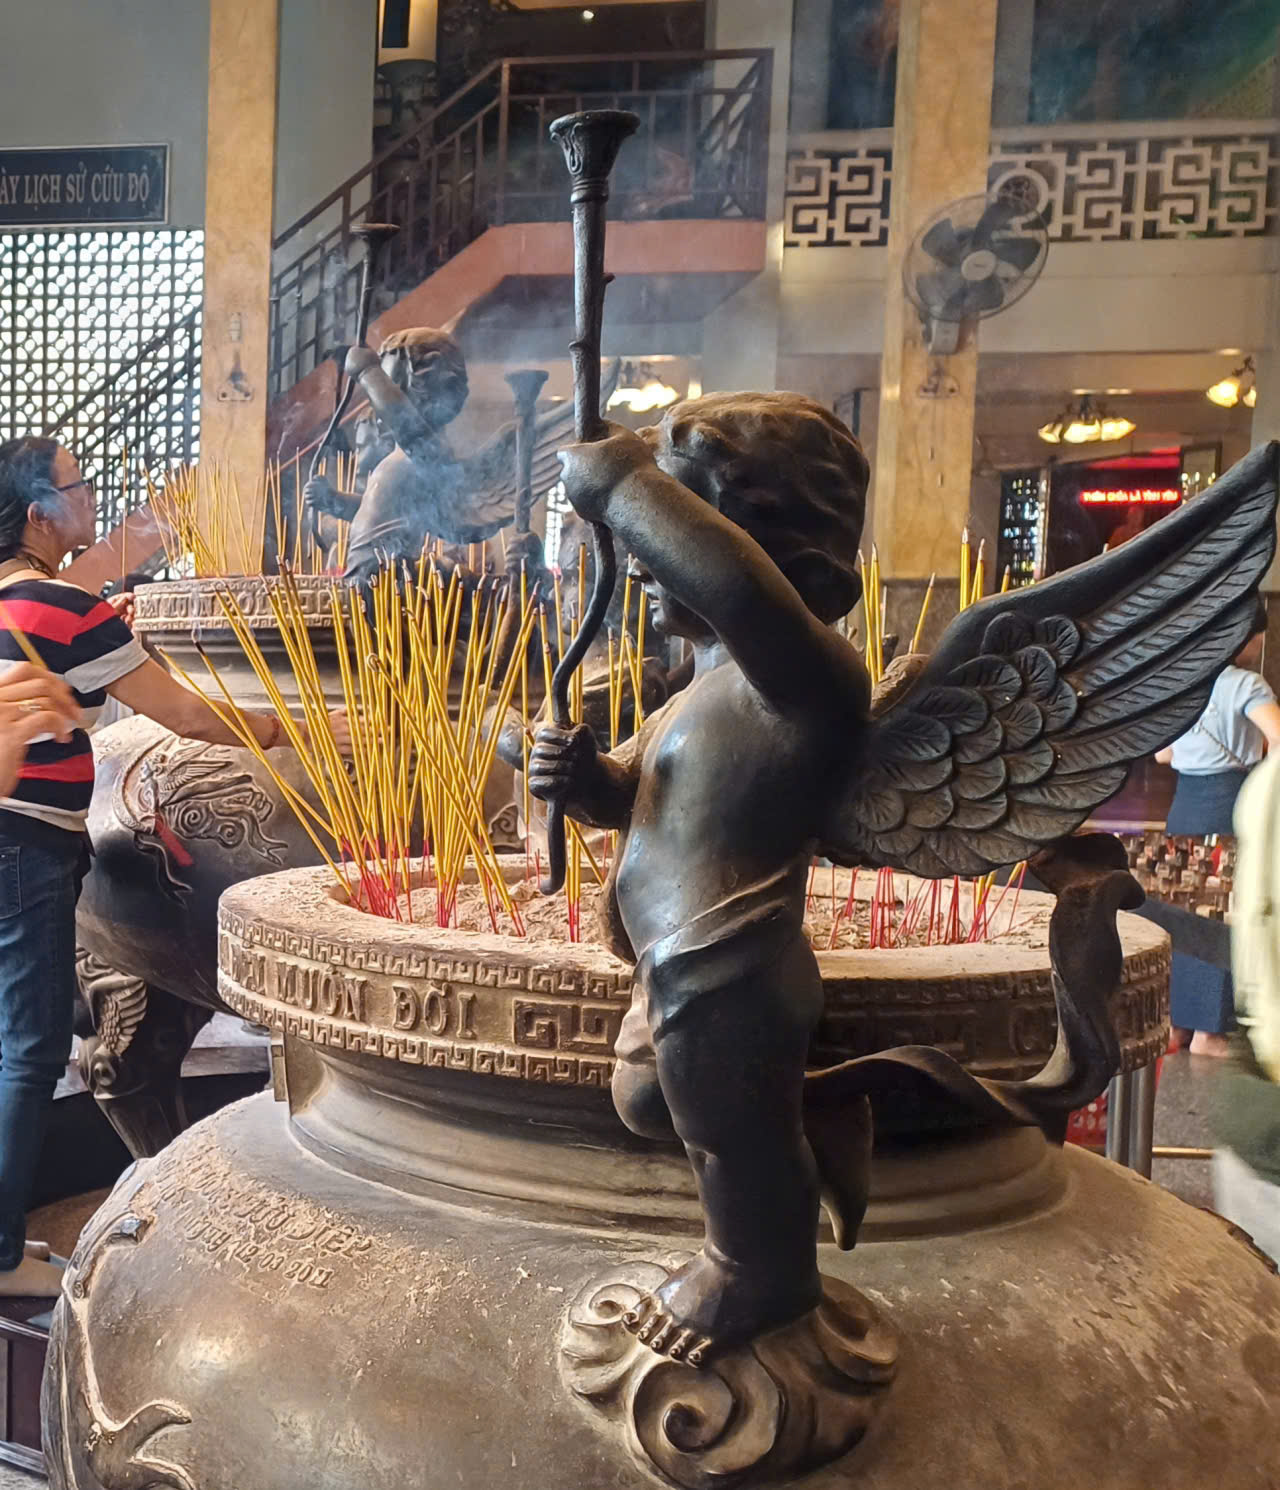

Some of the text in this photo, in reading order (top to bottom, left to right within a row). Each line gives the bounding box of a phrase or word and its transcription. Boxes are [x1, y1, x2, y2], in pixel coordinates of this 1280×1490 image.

[24, 173, 62, 212] LỊCH
[66, 161, 88, 203] SỬ
[91, 164, 124, 202] CỨU
[128, 164, 150, 208] ĐỘ
[276, 961, 368, 1023] MUÔN
[392, 980, 479, 1041] ĐỜI
